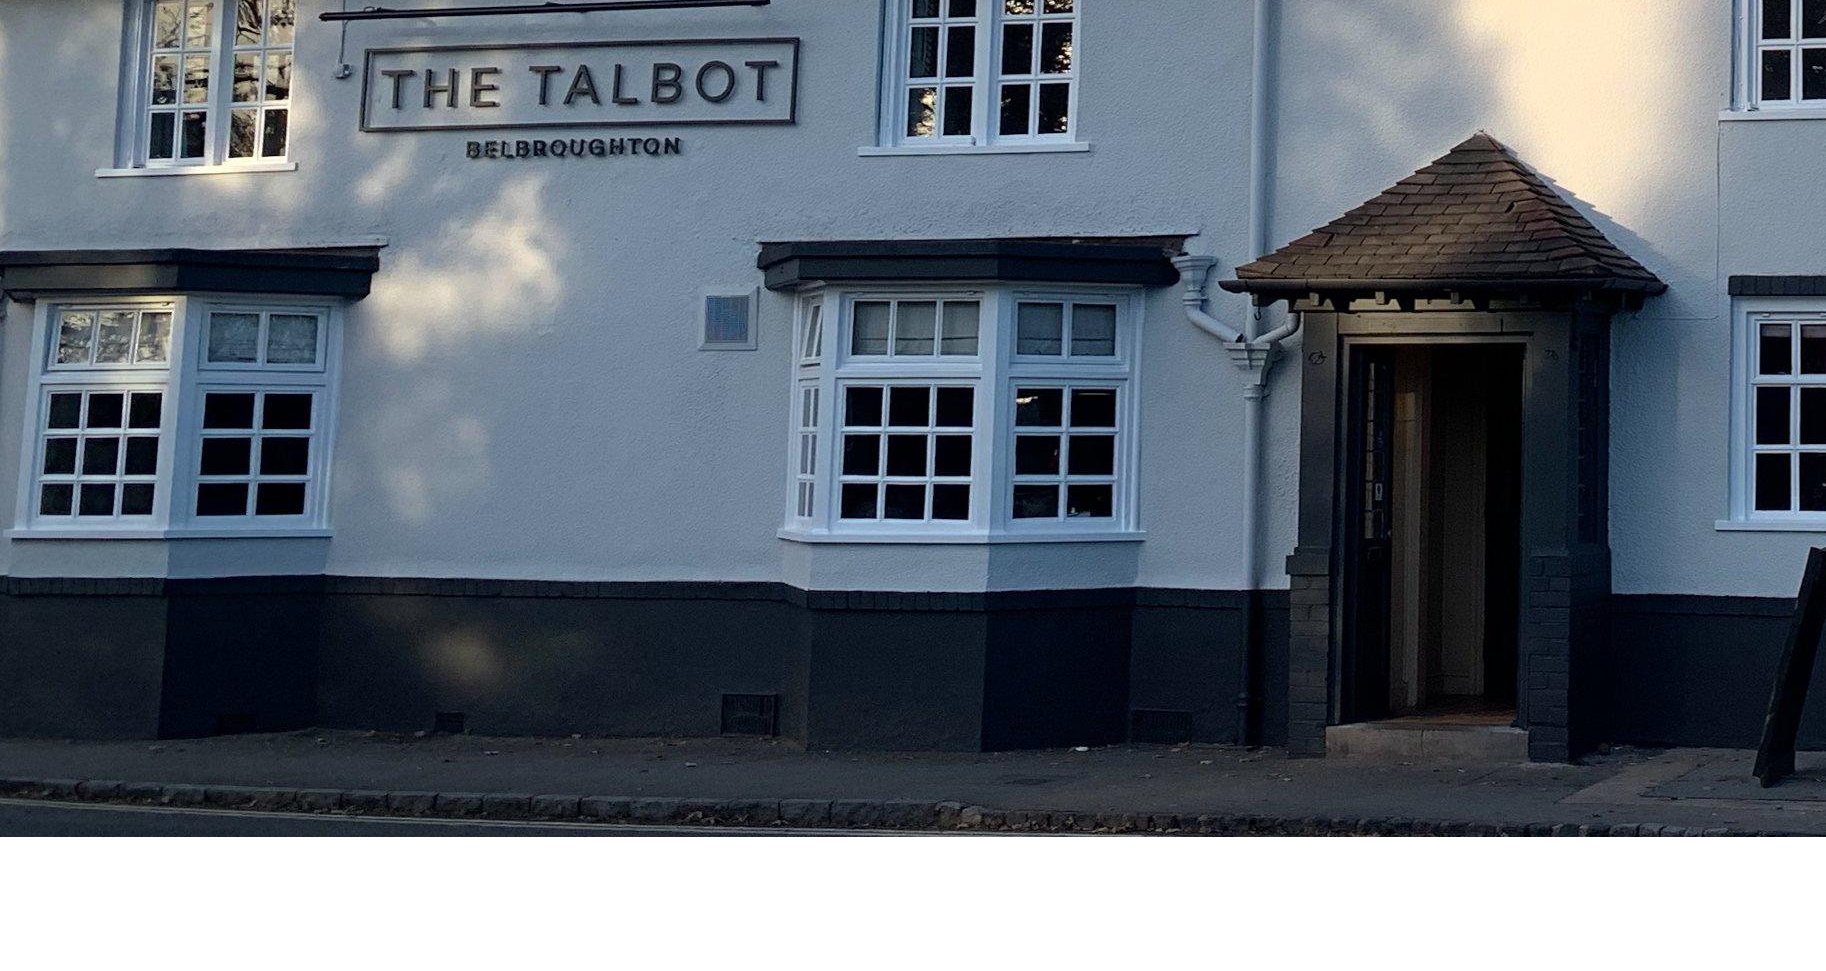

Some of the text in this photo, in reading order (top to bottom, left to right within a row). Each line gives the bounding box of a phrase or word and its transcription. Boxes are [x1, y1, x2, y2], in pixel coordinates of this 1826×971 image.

[381, 60, 779, 109] THE TALBOT
[465, 136, 684, 159] BELBROUGHTON
